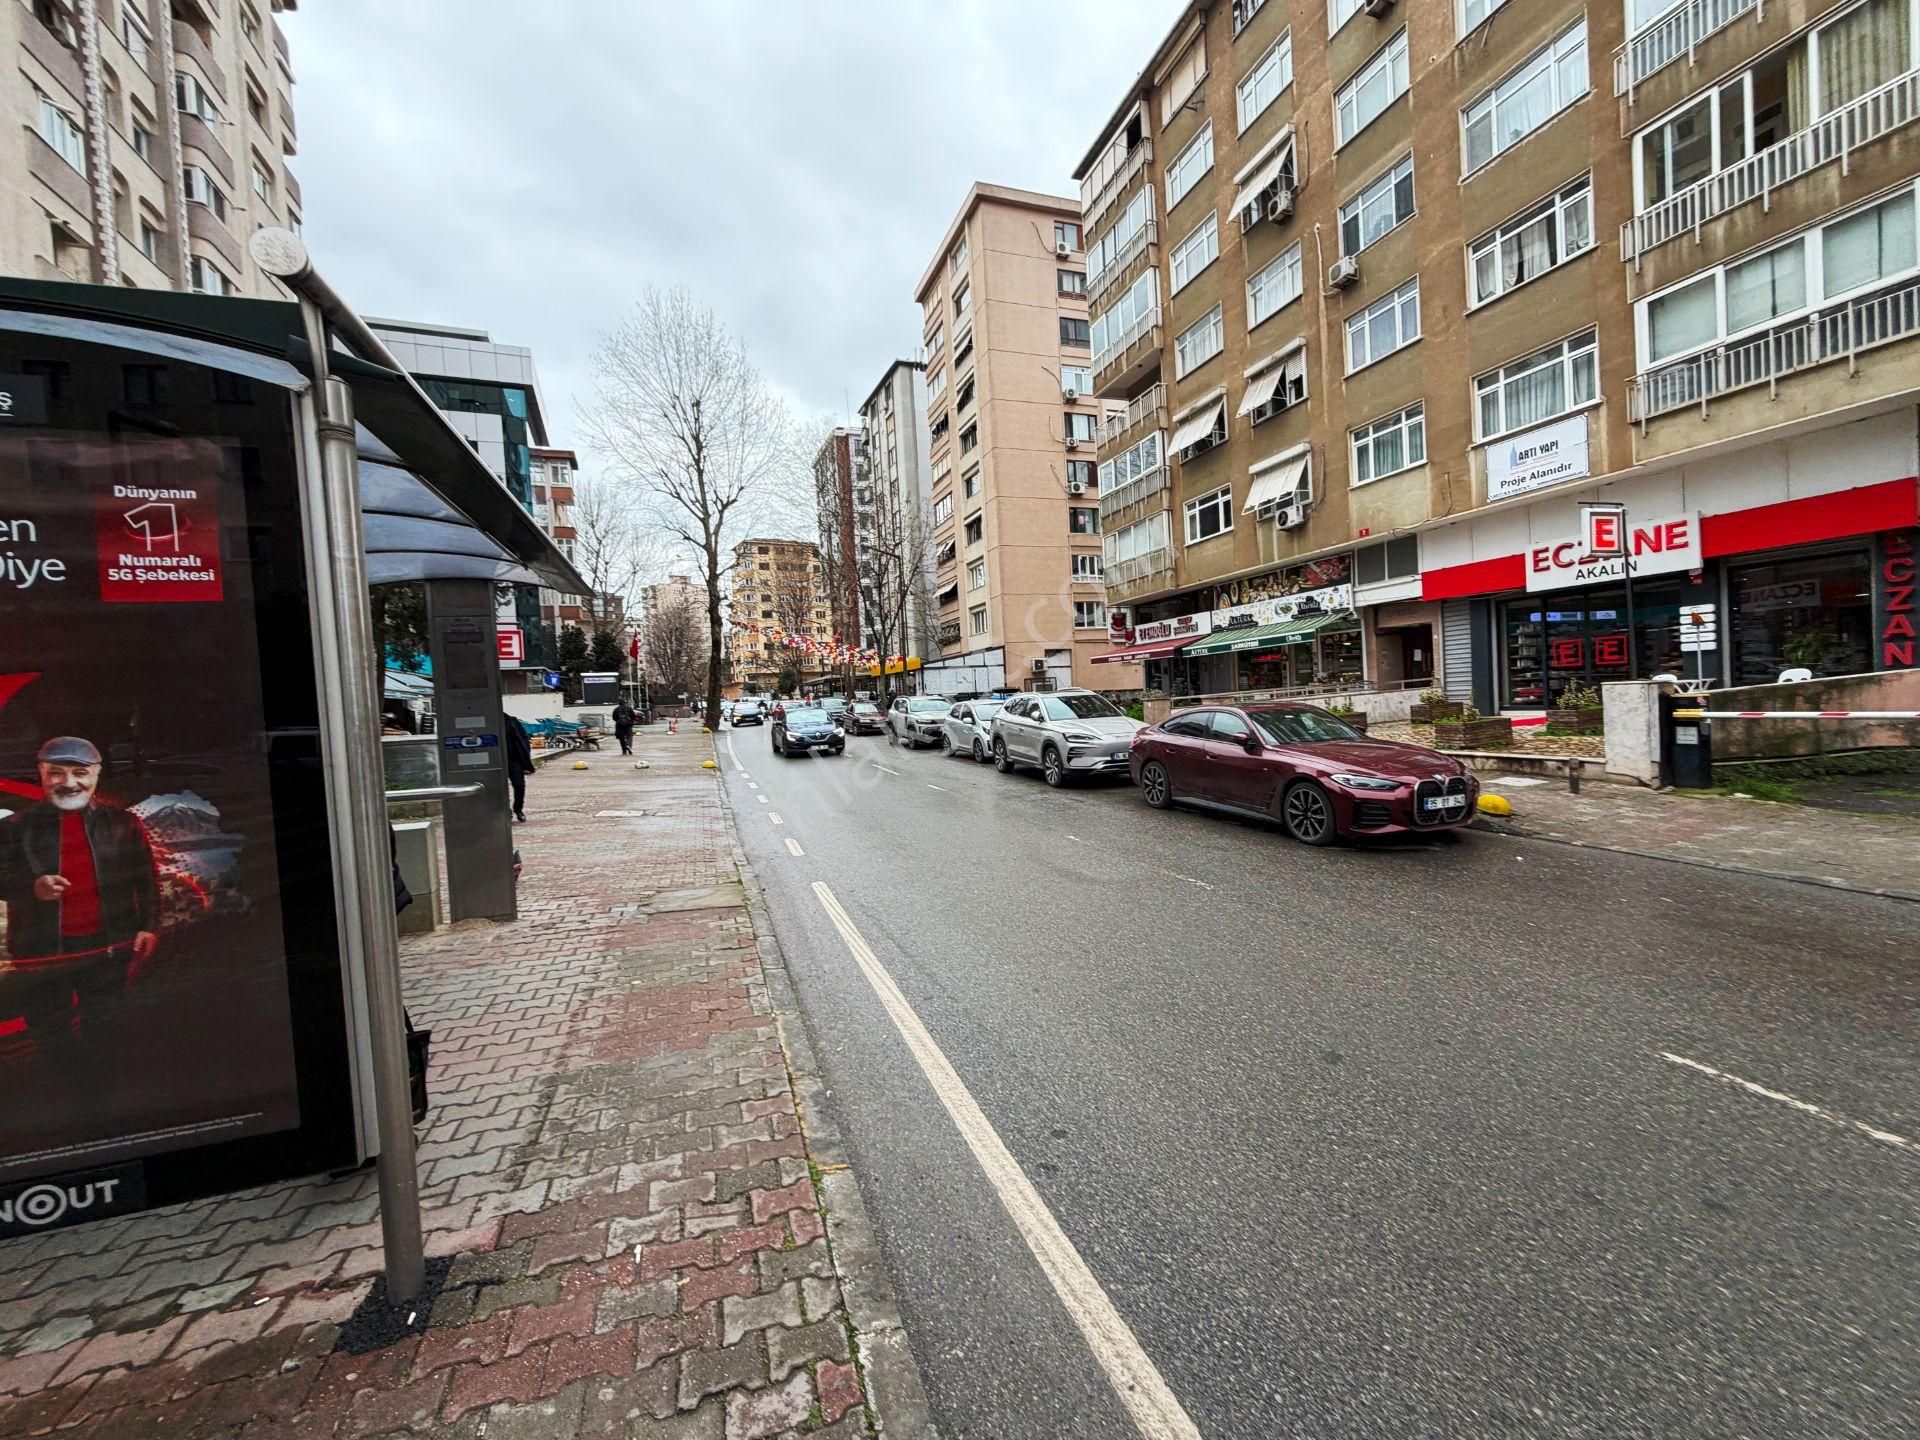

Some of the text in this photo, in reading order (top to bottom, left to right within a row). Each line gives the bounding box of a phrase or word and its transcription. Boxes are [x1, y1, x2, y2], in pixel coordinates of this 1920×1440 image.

[1518, 446, 1537, 462] ARTI
[1540, 440, 1559, 455] YAPI
[1500, 475, 1527, 489] Proje
[1529, 463, 1573, 481] Alanıdır
[113, 485, 197, 501] Dünyanın
[1594, 518, 1616, 549] E
[0, 551, 67, 589] iye
[118, 554, 202, 567] Numaralı
[108, 568, 215, 584] 5G Şebekesi
[1560, 643, 1575, 663] E
[1603, 640, 1619, 660] E
